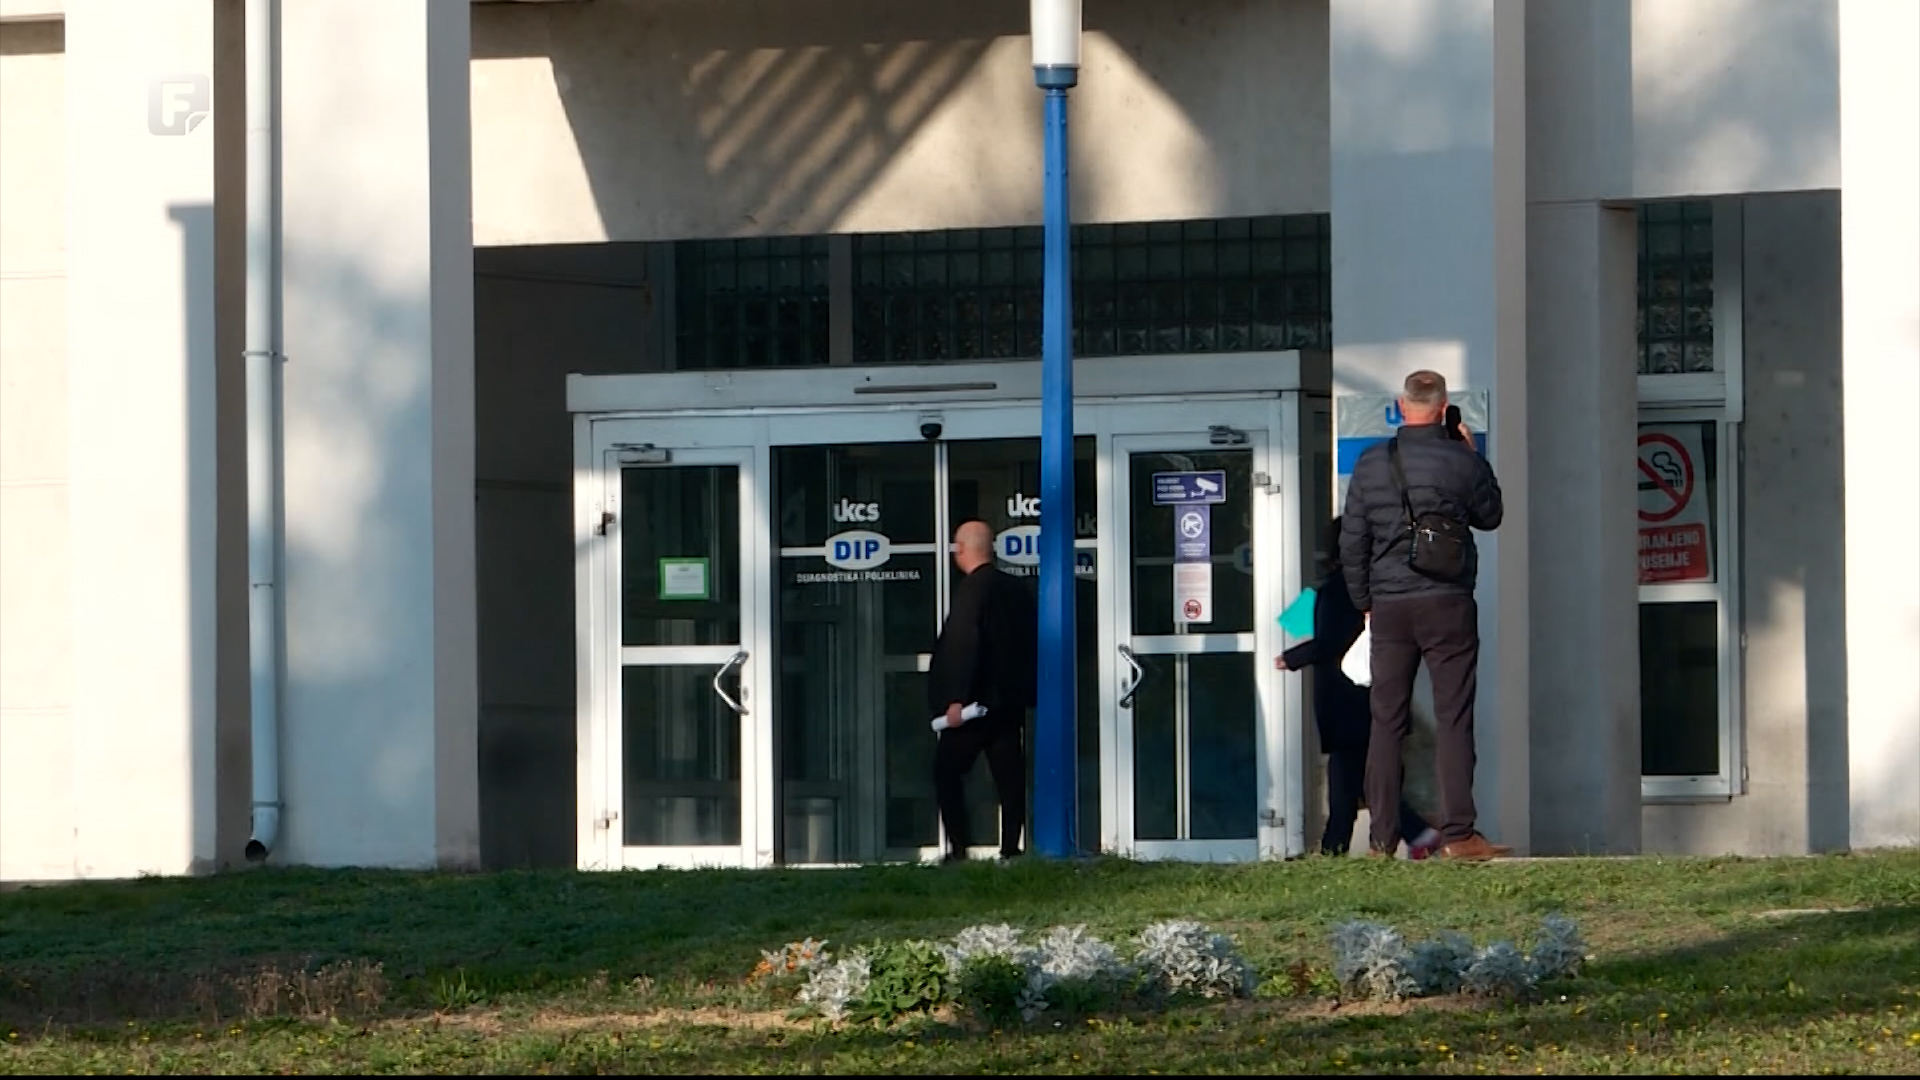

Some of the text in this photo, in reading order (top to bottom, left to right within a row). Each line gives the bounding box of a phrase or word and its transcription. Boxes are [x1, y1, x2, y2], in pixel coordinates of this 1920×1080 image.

[833, 498, 880, 521] ukcs
[1007, 493, 1042, 517] ukc
[834, 540, 880, 560] DIP
[1005, 534, 1041, 556] DI
[1639, 530, 1701, 550] RANJENO
[1640, 550, 1691, 569] UŠENJE
